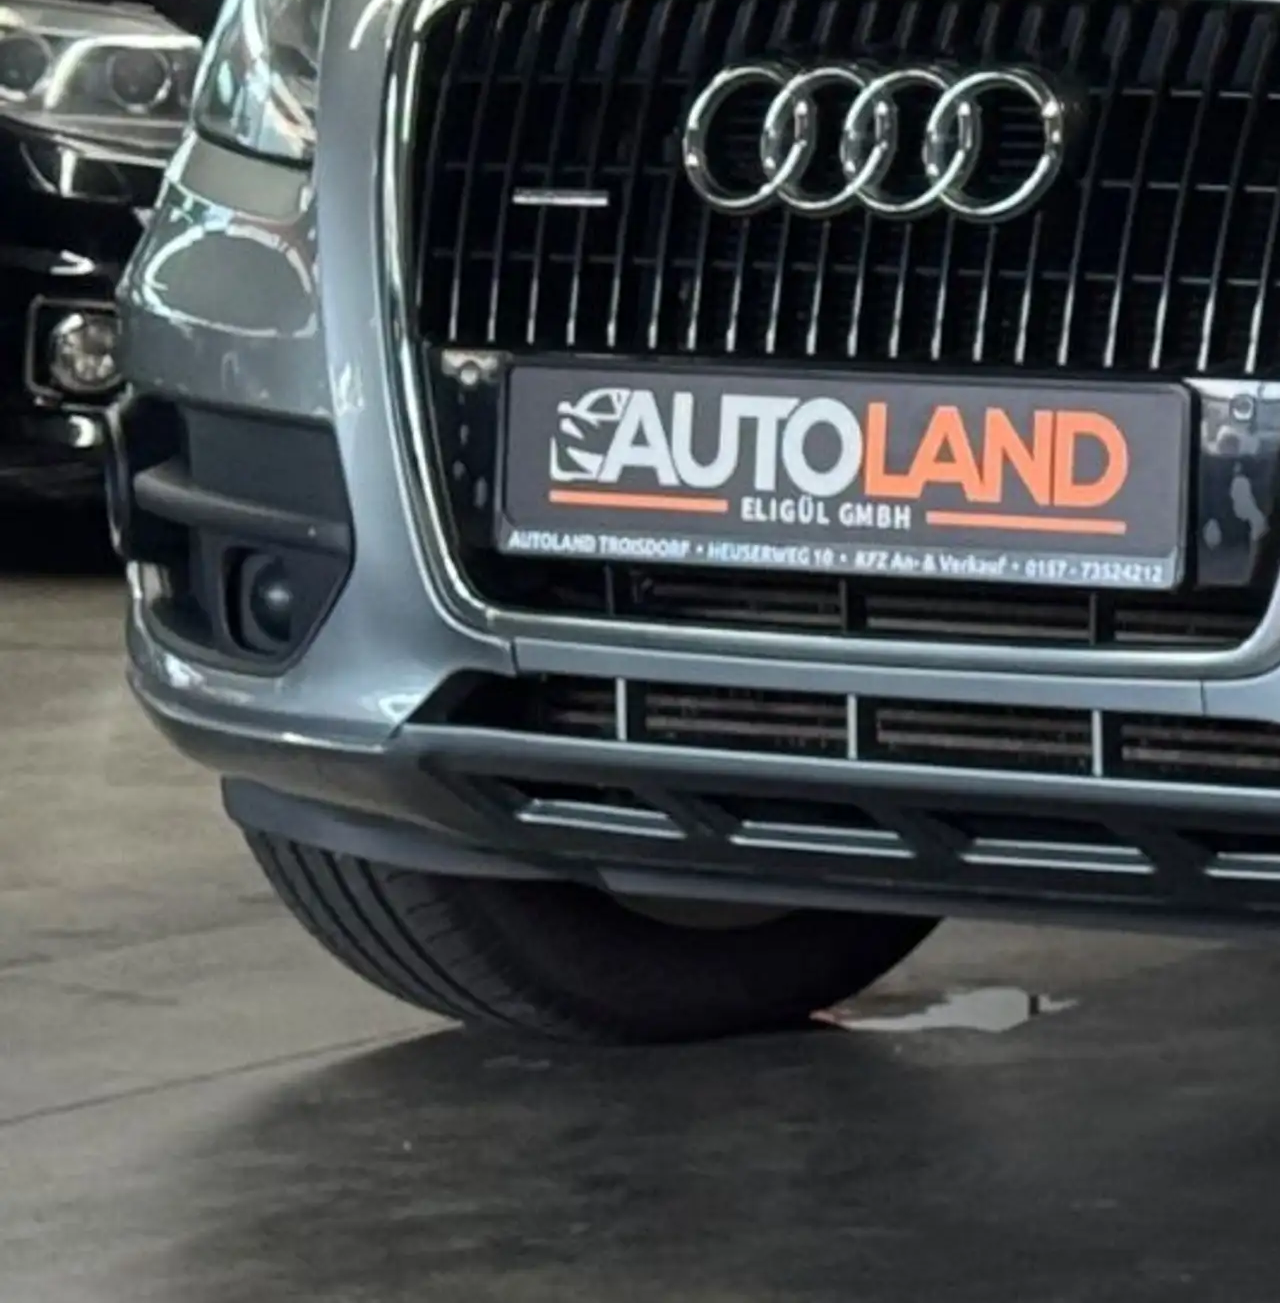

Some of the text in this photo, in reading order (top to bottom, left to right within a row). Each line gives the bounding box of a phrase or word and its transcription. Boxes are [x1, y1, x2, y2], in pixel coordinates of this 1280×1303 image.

[600, 388, 1129, 508] AUTOLAND
[740, 495, 912, 530] ELIGÜL GMBH
[508, 530, 596, 554] AUTOLAND
[598, 535, 690, 559] TROISDORF
[706, 541, 810, 567] HEUSERWEG
[813, 547, 835, 567] 10
[854, 549, 887, 570] KFZ
[938, 552, 1007, 575] Verkauf
